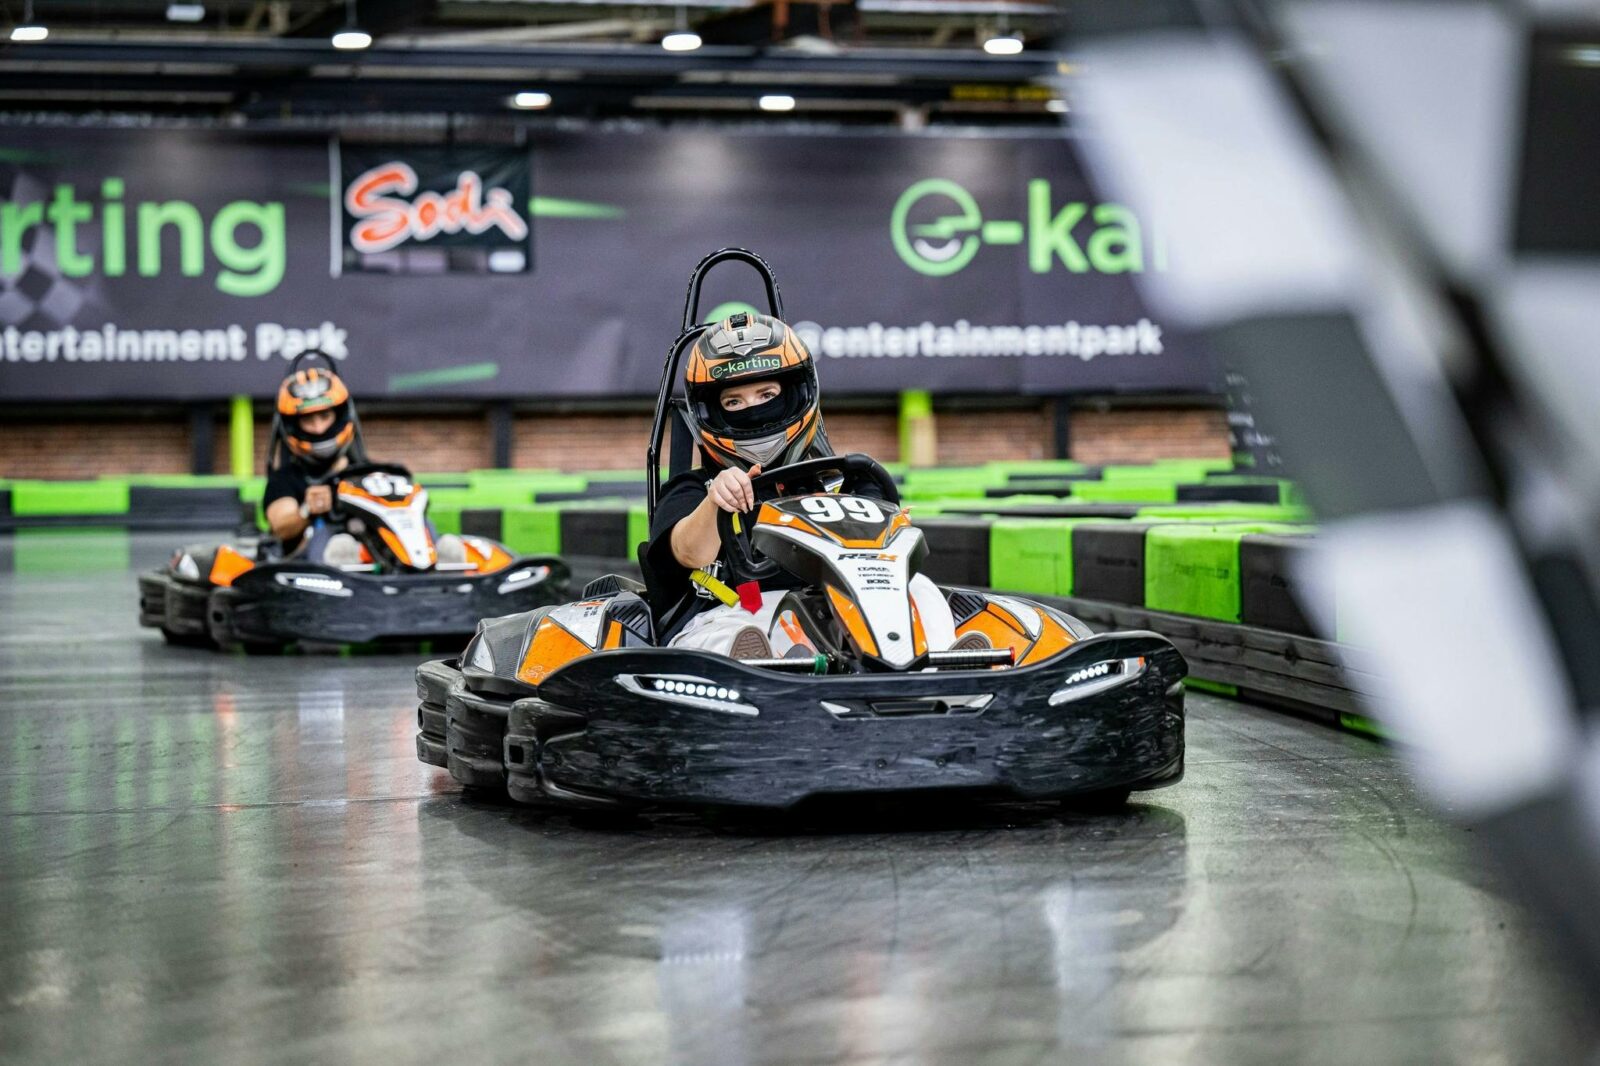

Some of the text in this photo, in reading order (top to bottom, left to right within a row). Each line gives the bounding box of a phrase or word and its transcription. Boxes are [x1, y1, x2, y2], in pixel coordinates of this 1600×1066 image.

[344, 161, 529, 254] Sodi
[254, 321, 348, 361] Park
[711, 356, 781, 379] e-karting
[800, 497, 885, 523] 99
